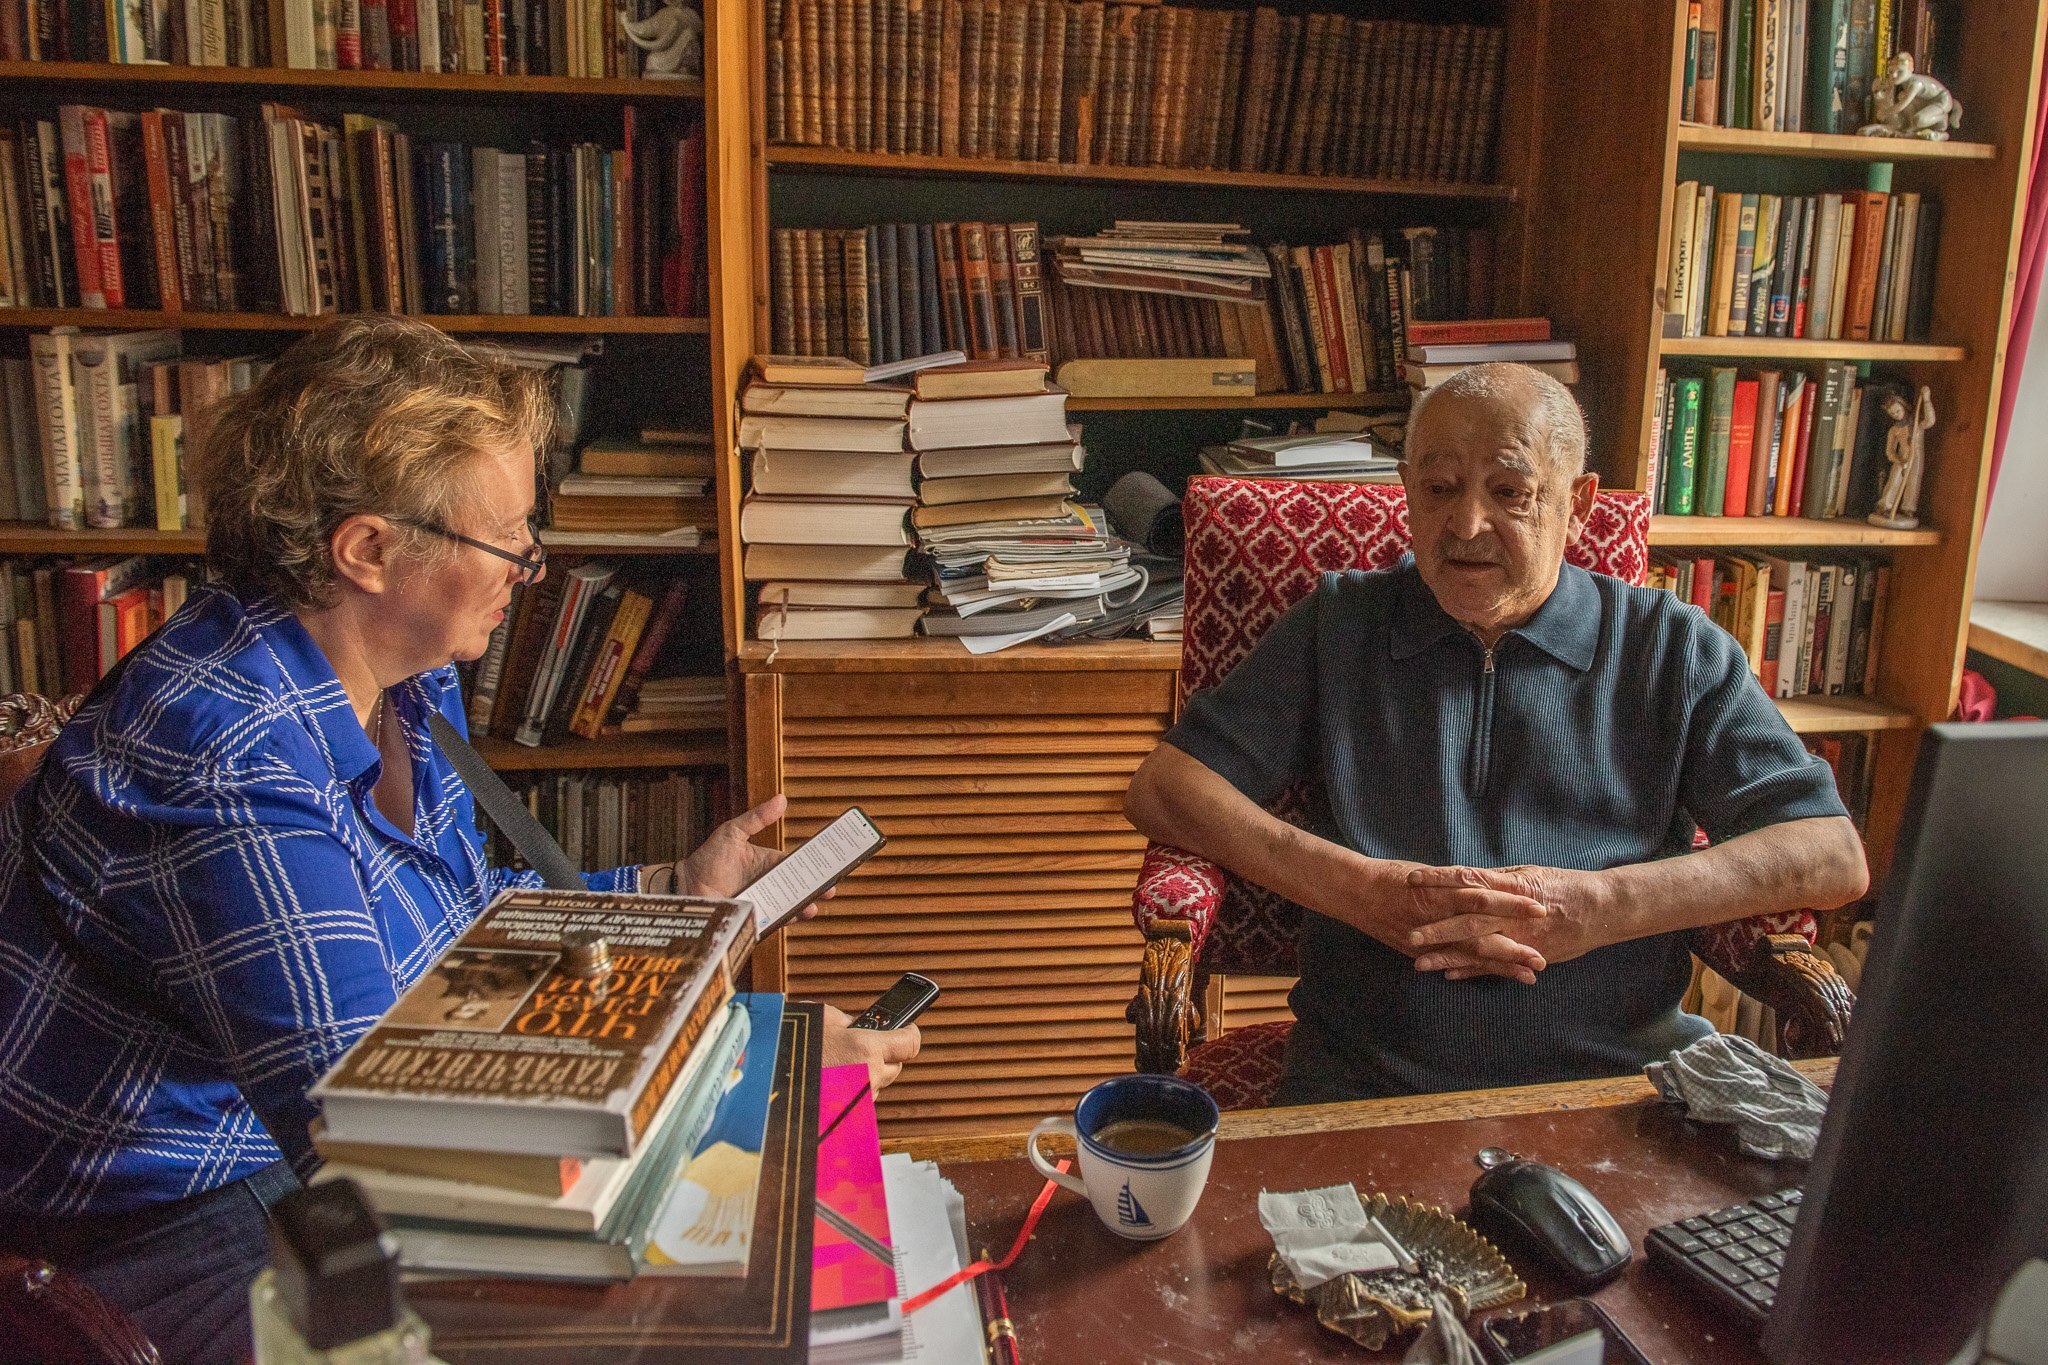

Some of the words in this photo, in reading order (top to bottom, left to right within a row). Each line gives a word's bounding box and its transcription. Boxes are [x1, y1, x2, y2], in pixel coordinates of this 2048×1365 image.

[1673, 239, 1689, 299] Наоборот
[1734, 272, 1749, 309] ПРУСТ
[48, 372, 63, 419] ОХТА
[95, 371, 108, 410] ОХТА
[52, 424, 69, 486] МАЛАЯ
[99, 415, 116, 485] БОЛЬШАЯ
[1683, 427, 1694, 467] ДАНТЕ
[543, 899, 599, 907] ЛЮДИ
[616, 903, 680, 911] ЭПОХА
[566, 913, 605, 923] ДВУХ
[602, 915, 654, 925] МЕЖДУ
[652, 916, 708, 928] ИСТОРИИ
[506, 931, 564, 941] ЧЕВИДЦА
[547, 972, 671, 996] МОИ
[528, 994, 657, 1015] ГЛАЗА
[515, 1012, 637, 1039] ЧТО
[354, 1048, 622, 1083] КАРАБЧЕВСКИЙ
